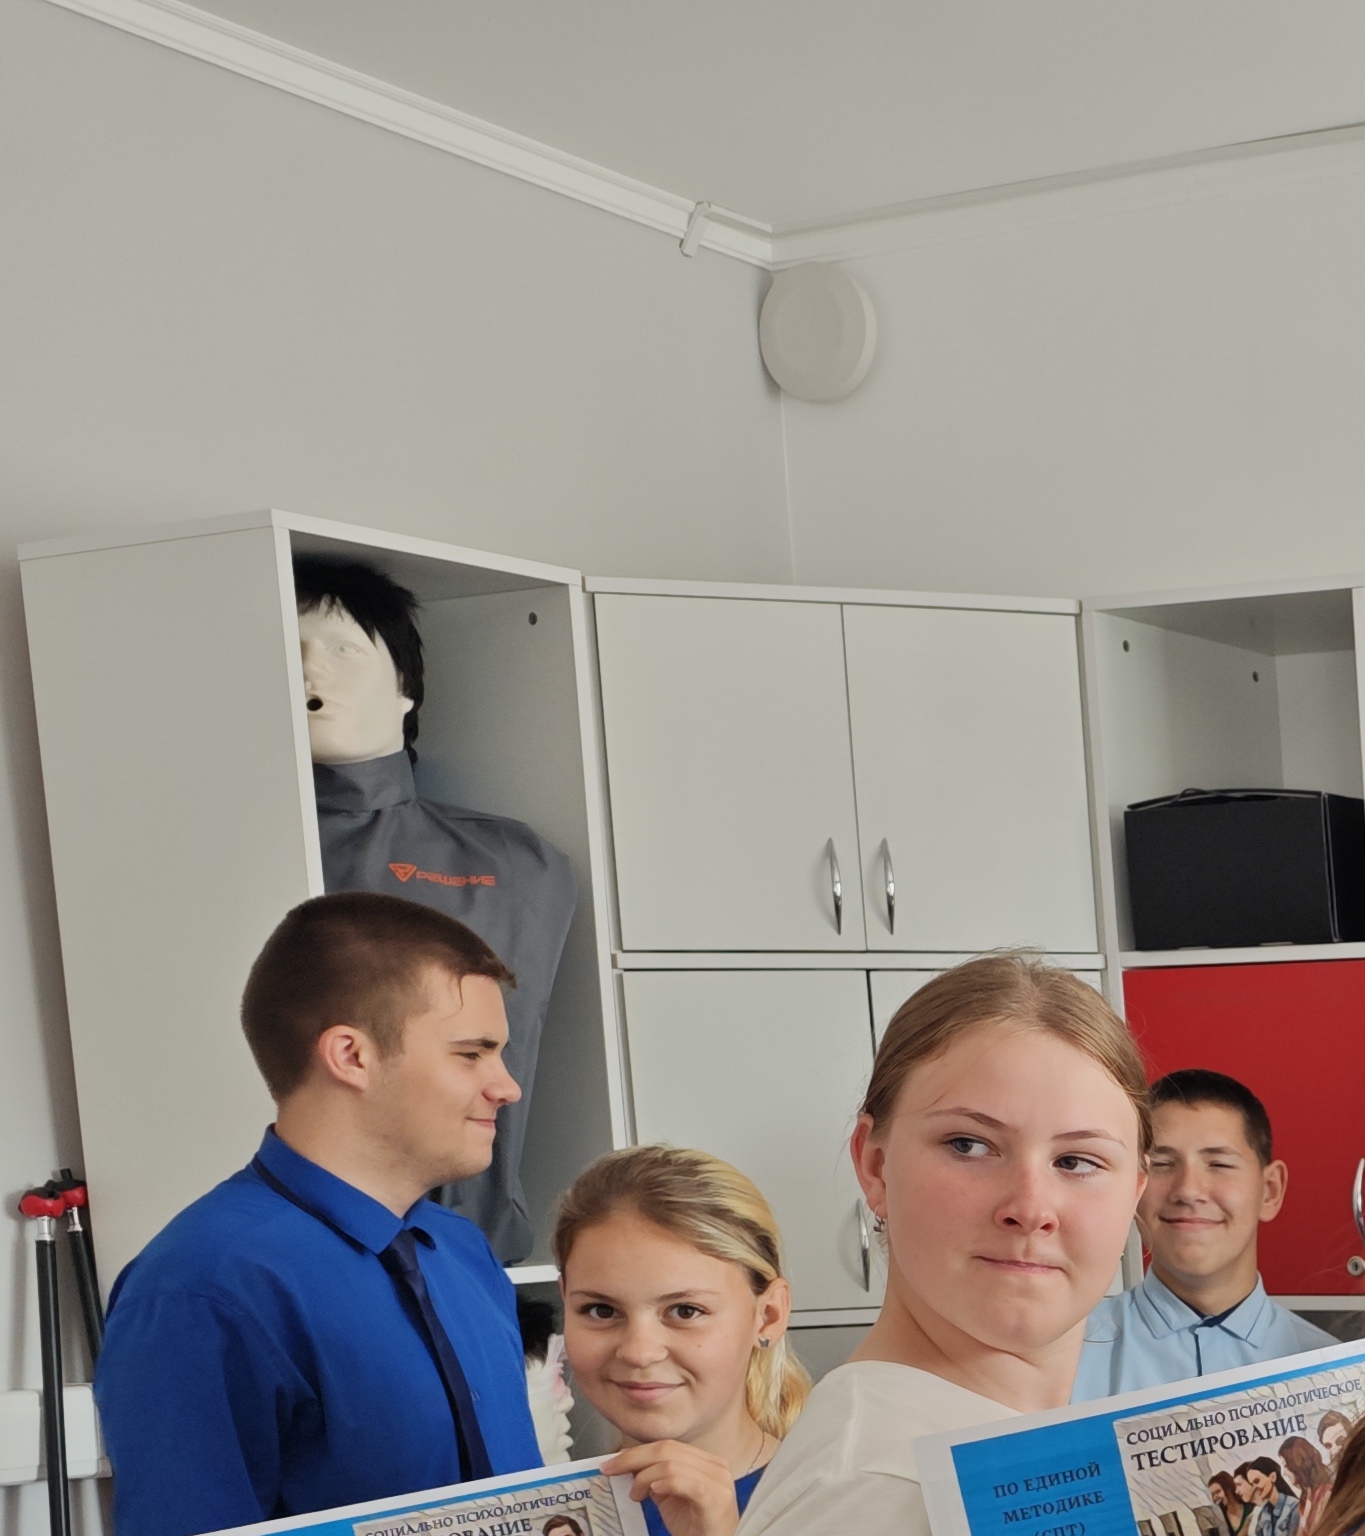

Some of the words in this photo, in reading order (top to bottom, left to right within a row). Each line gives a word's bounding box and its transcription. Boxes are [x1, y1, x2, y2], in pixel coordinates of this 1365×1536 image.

[1126, 1411, 1226, 1445] СОЦИАЛЬНО
[1228, 1378, 1362, 1422] ПСИХОЛОГИЧЕСКОЕ
[1131, 1413, 1309, 1471] ТЕСТИРОВАНИЕ
[992, 1483, 1019, 1500] ПО
[1024, 1460, 1102, 1493] ЕДИНОЙ
[456, 1488, 593, 1527] ПСИХОЛОГИЧЕСКОЕ
[1002, 1490, 1106, 1524] МЕТОДИКЕ
